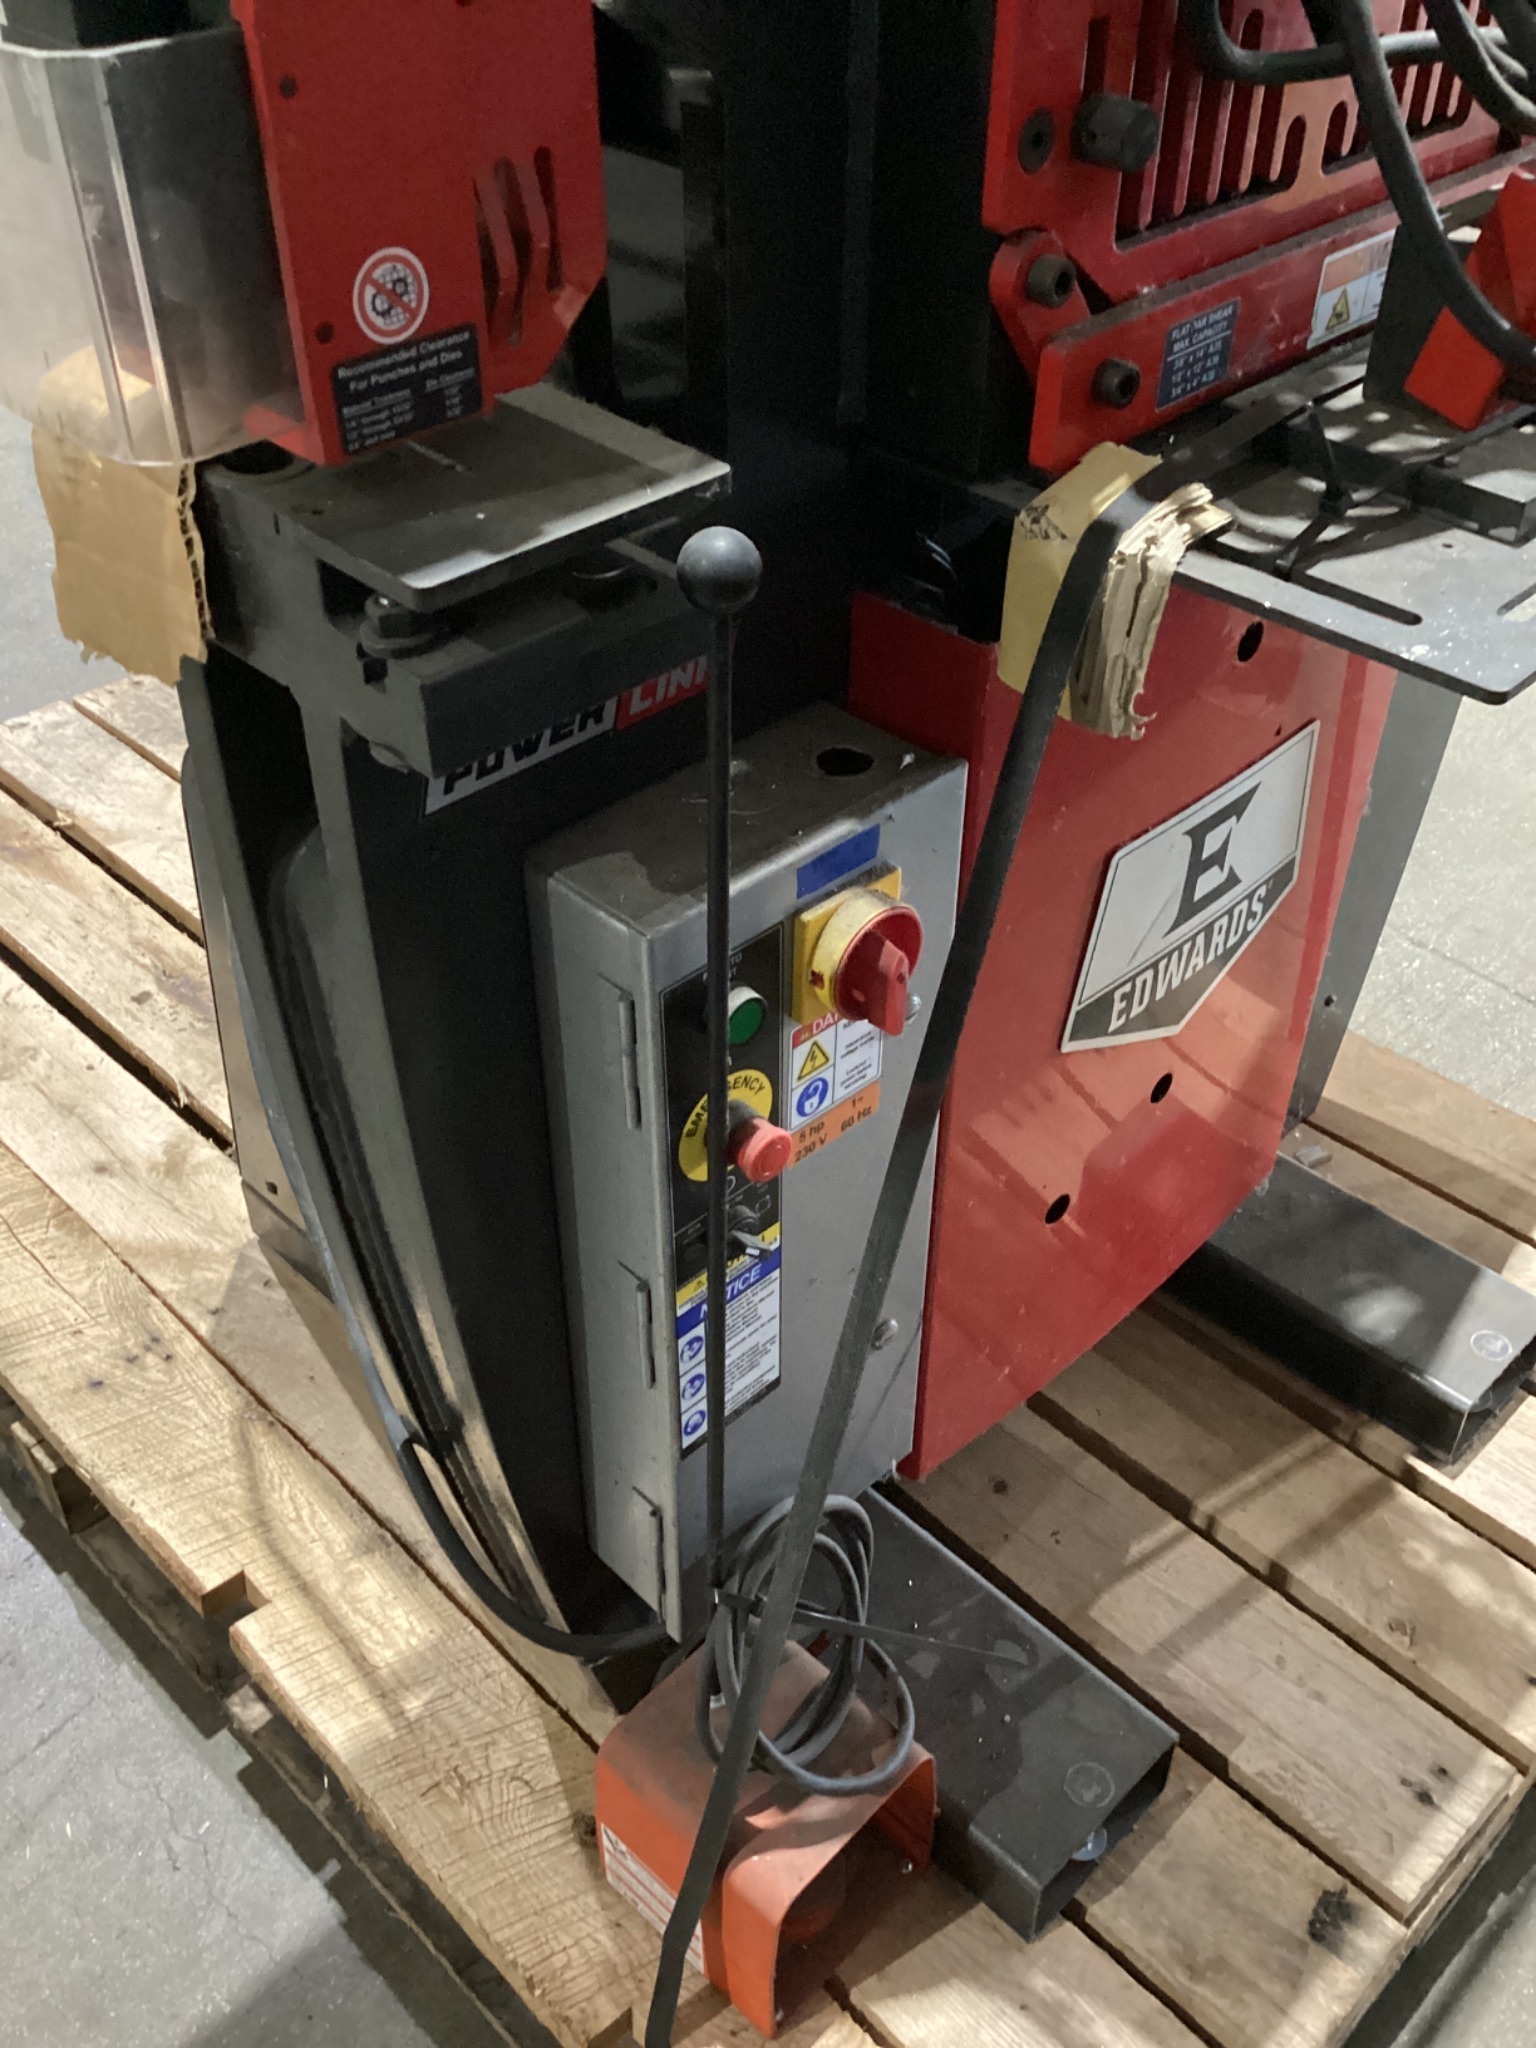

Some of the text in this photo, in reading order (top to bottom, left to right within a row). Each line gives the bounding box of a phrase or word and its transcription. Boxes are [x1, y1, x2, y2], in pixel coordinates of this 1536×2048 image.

[338, 331, 470, 379] Recommended Clearance
[349, 350, 463, 392] For Punches and Dies
[1161, 780, 1262, 939] E
[1108, 884, 1268, 1034] EDWARDS
[799, 1120, 825, 1143] 5 hp
[840, 1105, 873, 1132] 60 Hz
[794, 1133, 828, 1163] 230 V
